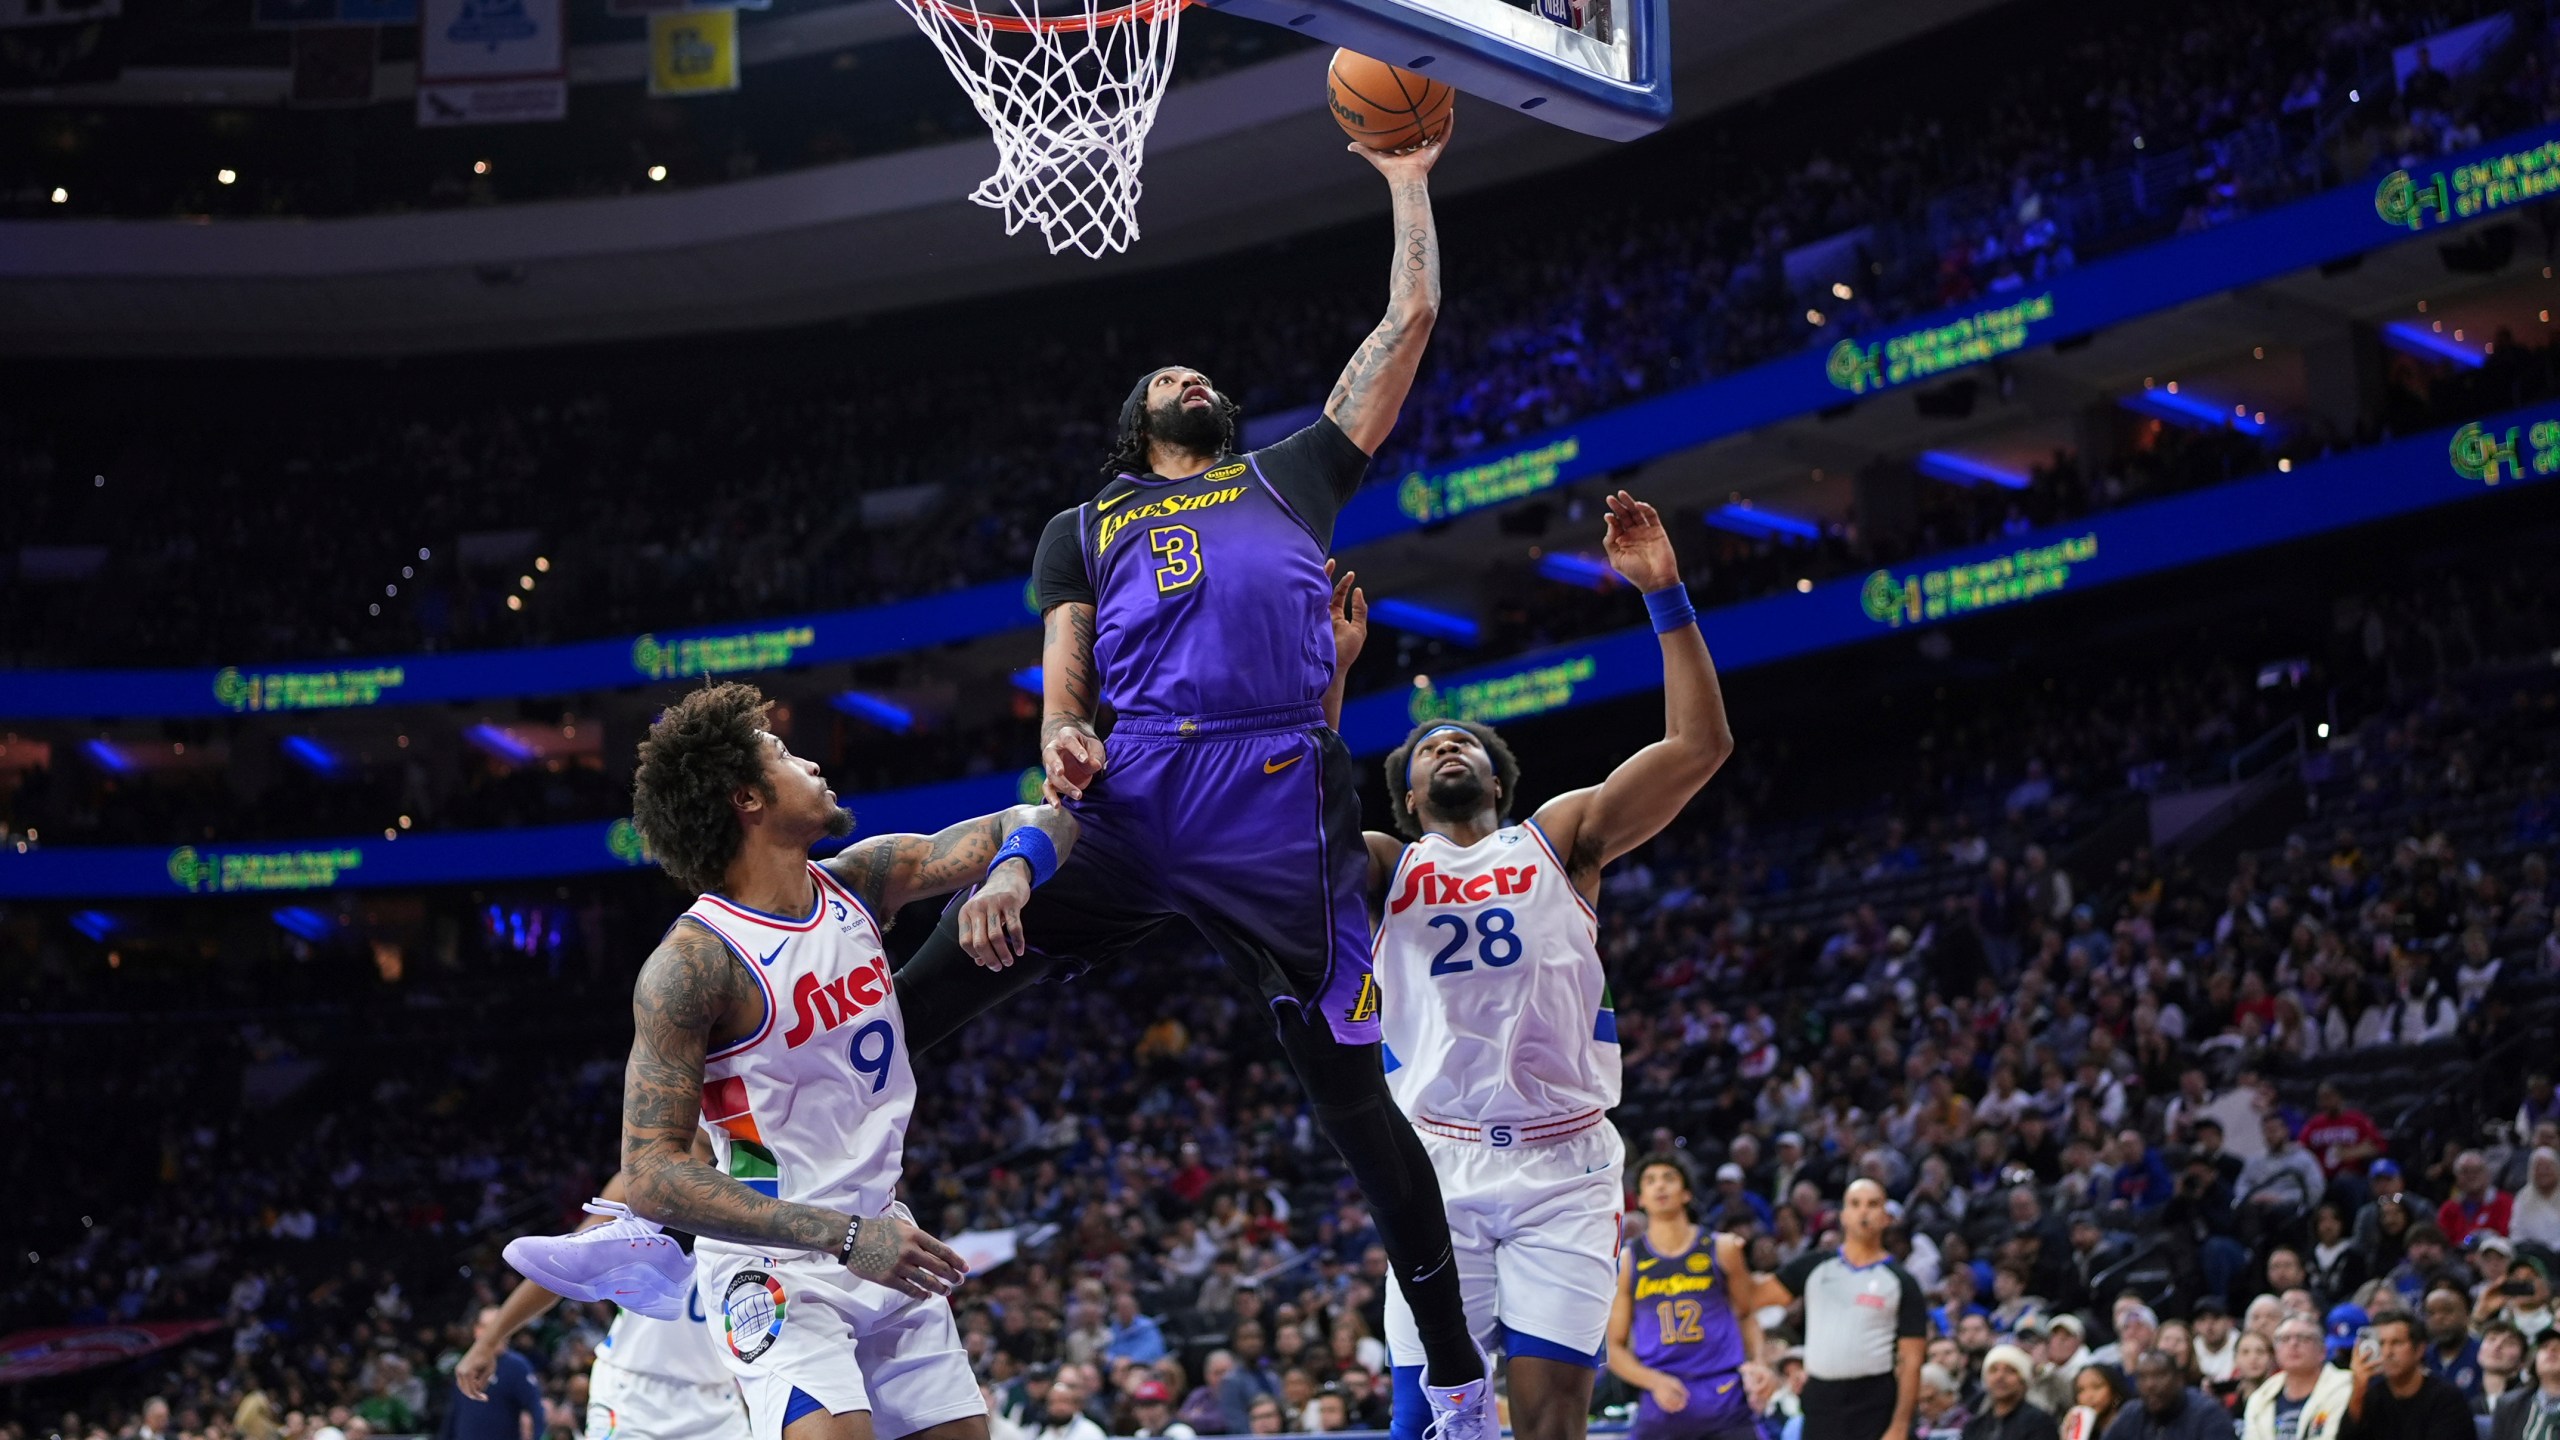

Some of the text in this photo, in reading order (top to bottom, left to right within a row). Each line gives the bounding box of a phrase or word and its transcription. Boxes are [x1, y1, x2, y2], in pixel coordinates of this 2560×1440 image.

[1544, 0, 1567, 20] NBA
[1208, 466, 1243, 479] bibigo
[1149, 523, 1206, 600] 3
[1391, 861, 1537, 915] Sixers
[1427, 907, 1522, 977] 28
[850, 1019, 895, 1095] 9
[1656, 1299, 1705, 1345] 12
